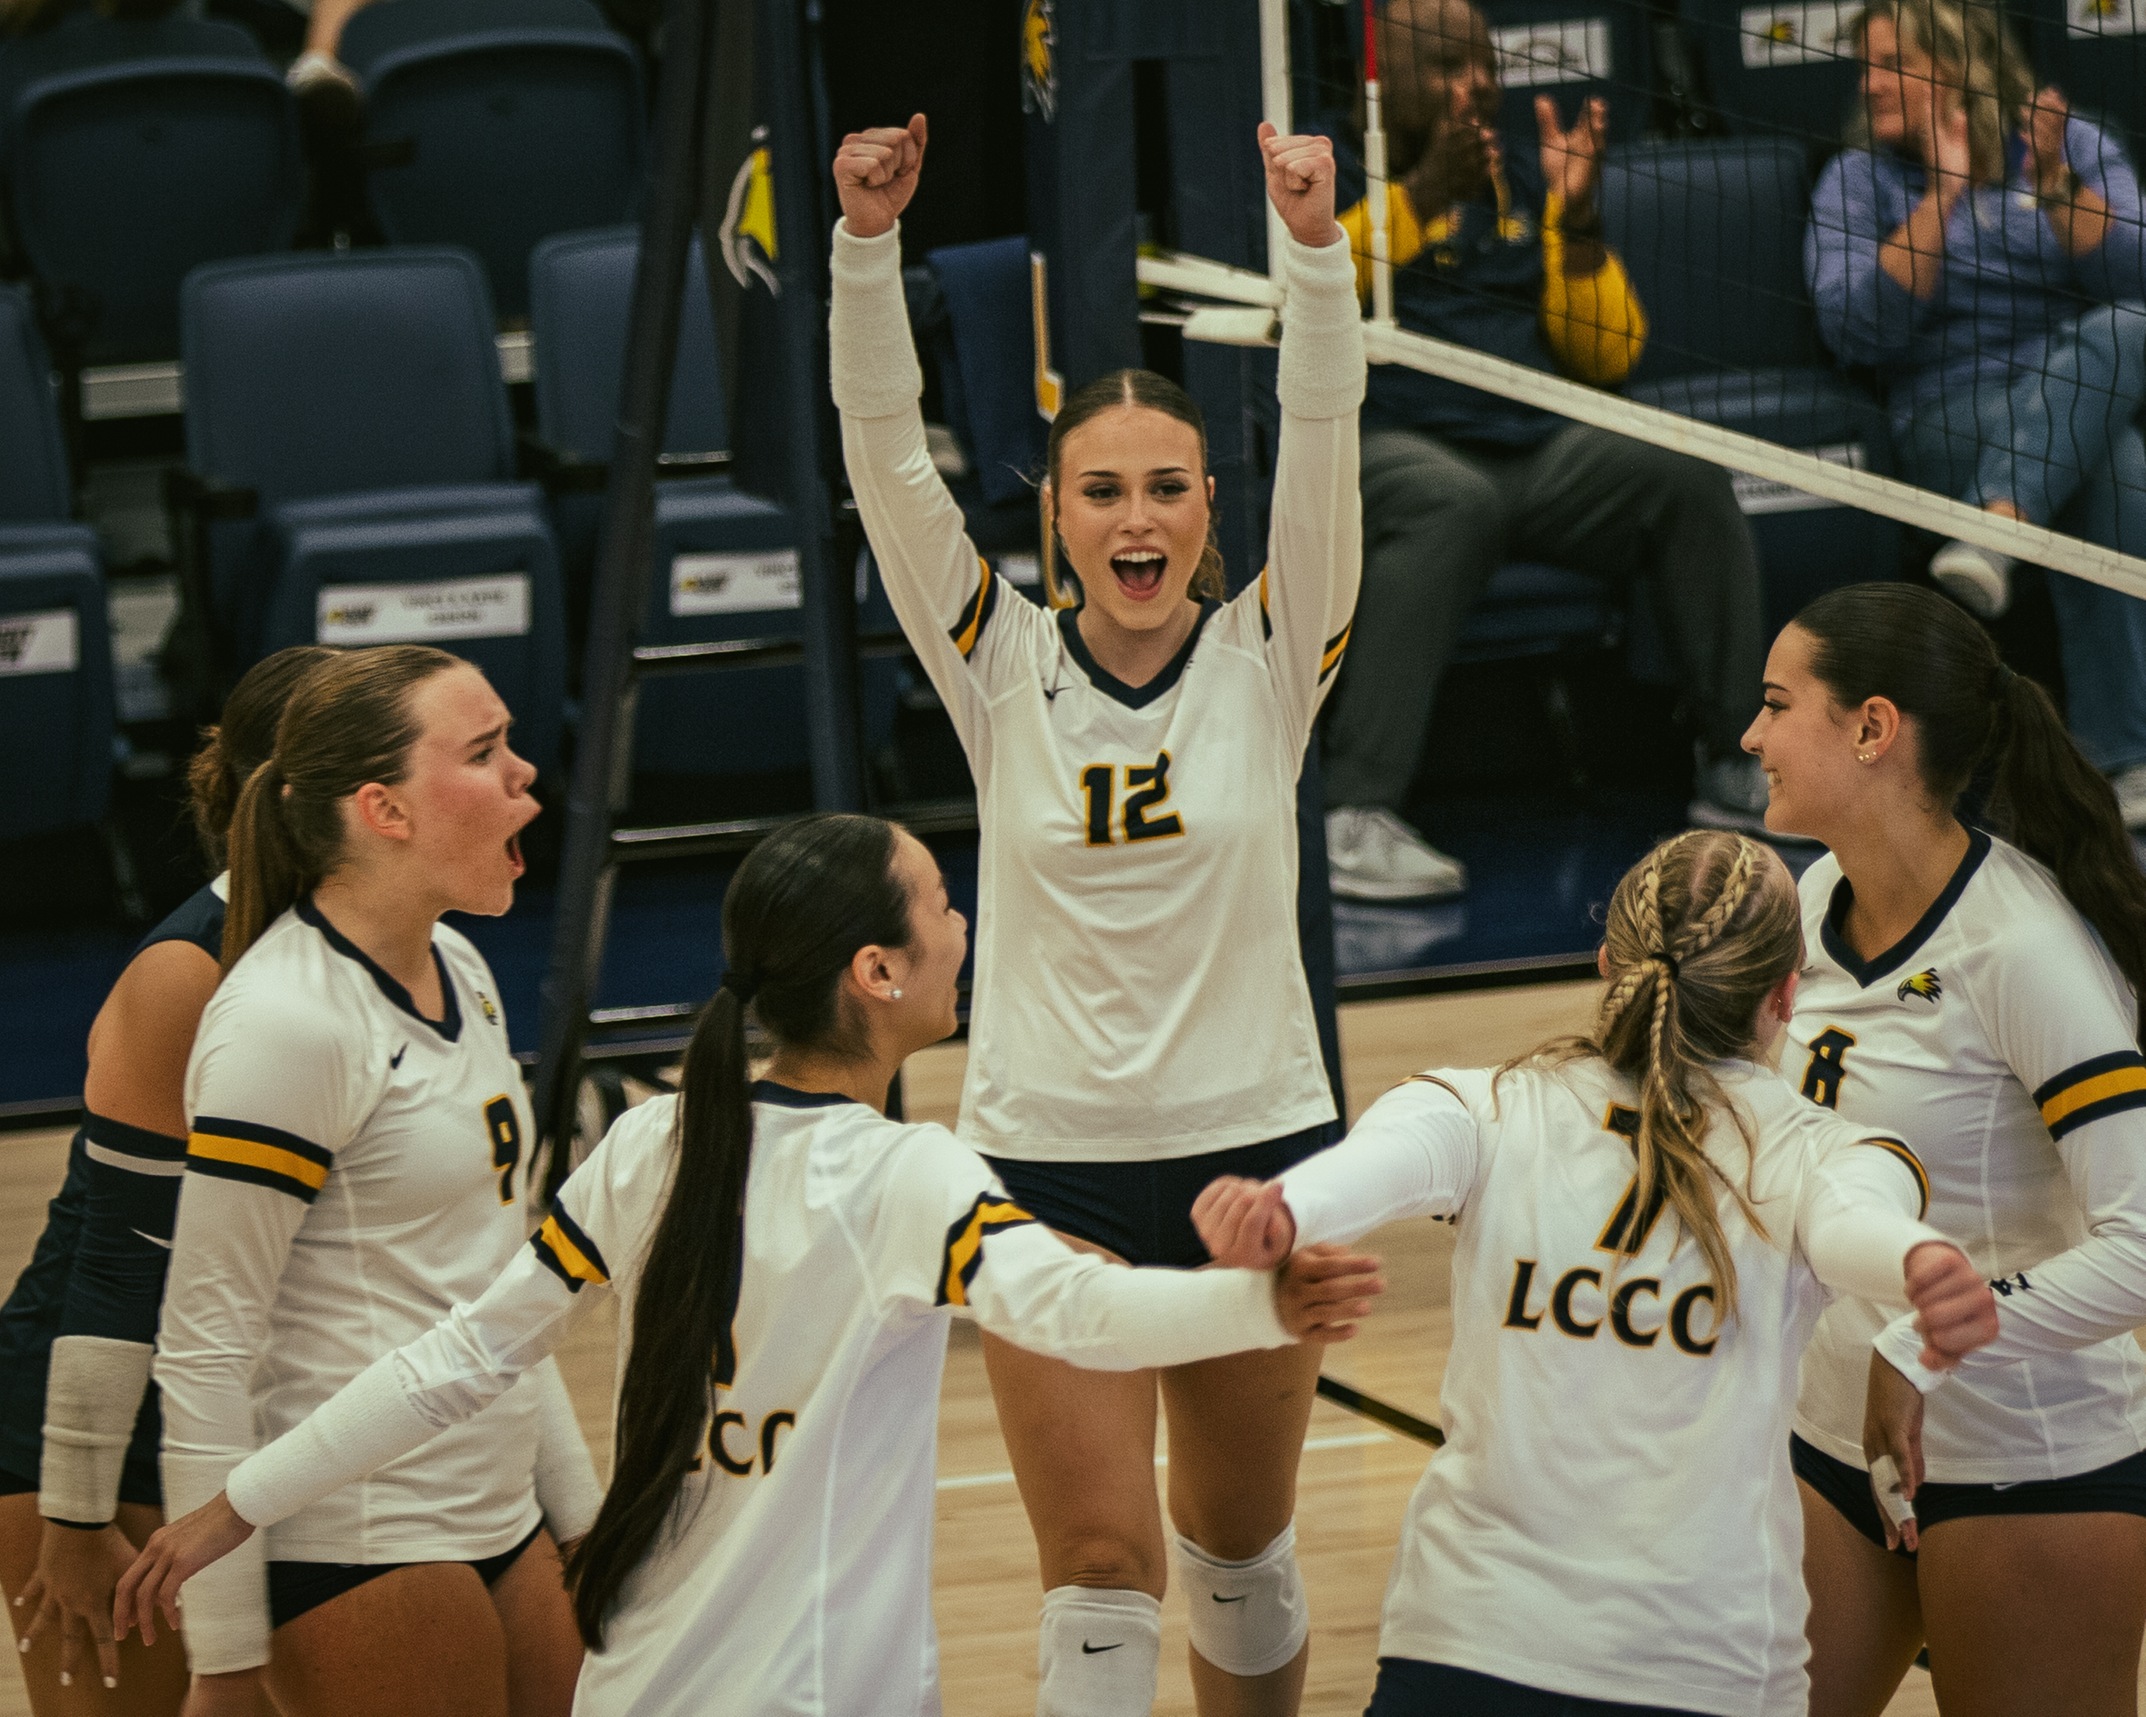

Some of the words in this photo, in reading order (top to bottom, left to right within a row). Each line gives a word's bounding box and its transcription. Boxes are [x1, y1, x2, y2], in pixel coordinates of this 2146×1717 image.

[1079, 749, 1185, 848] 12
[483, 1093, 523, 1207] 9
[1502, 1258, 1720, 1358] LCCC
